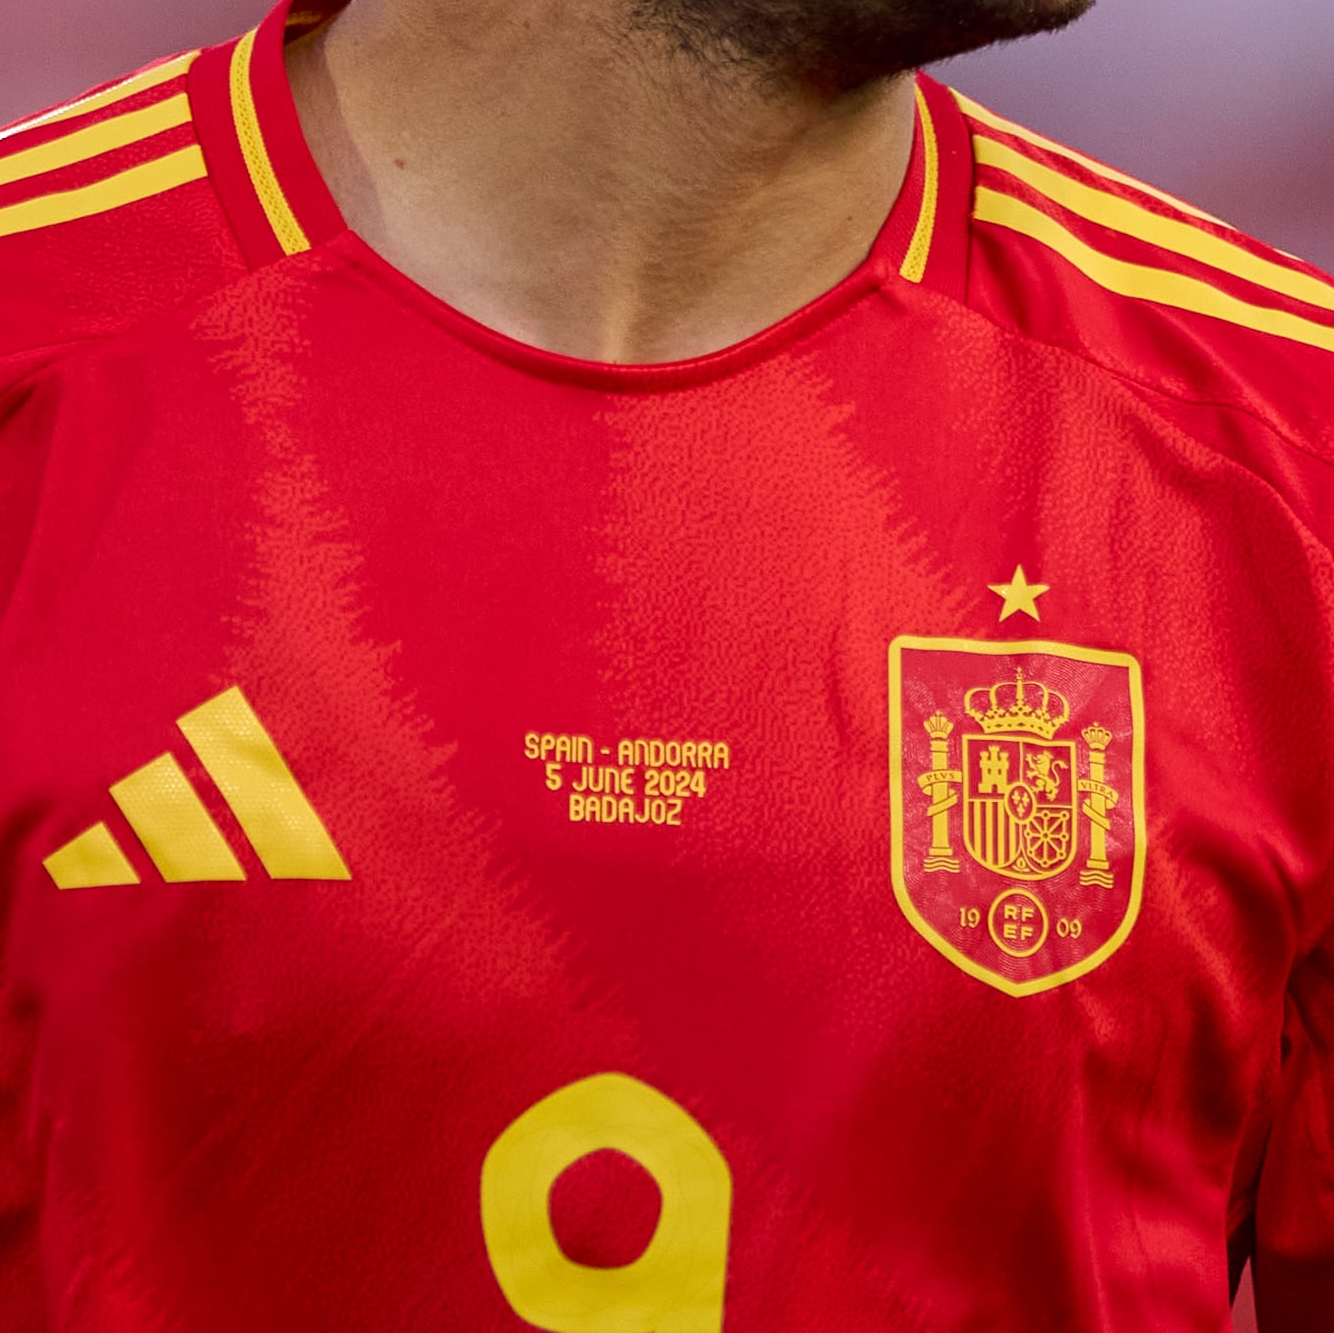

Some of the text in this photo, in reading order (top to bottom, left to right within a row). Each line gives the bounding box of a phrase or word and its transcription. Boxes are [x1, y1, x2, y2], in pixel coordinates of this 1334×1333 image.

[524, 733, 593, 764] SPAIN
[618, 740, 729, 769] ANDORRA
[545, 763, 706, 798] 5 JUNE 2024
[569, 794, 682, 825] BADAJOZ
[960, 907, 980, 928] 19
[1056, 918, 1082, 939] 09
[480, 1072, 733, 1333] 9
